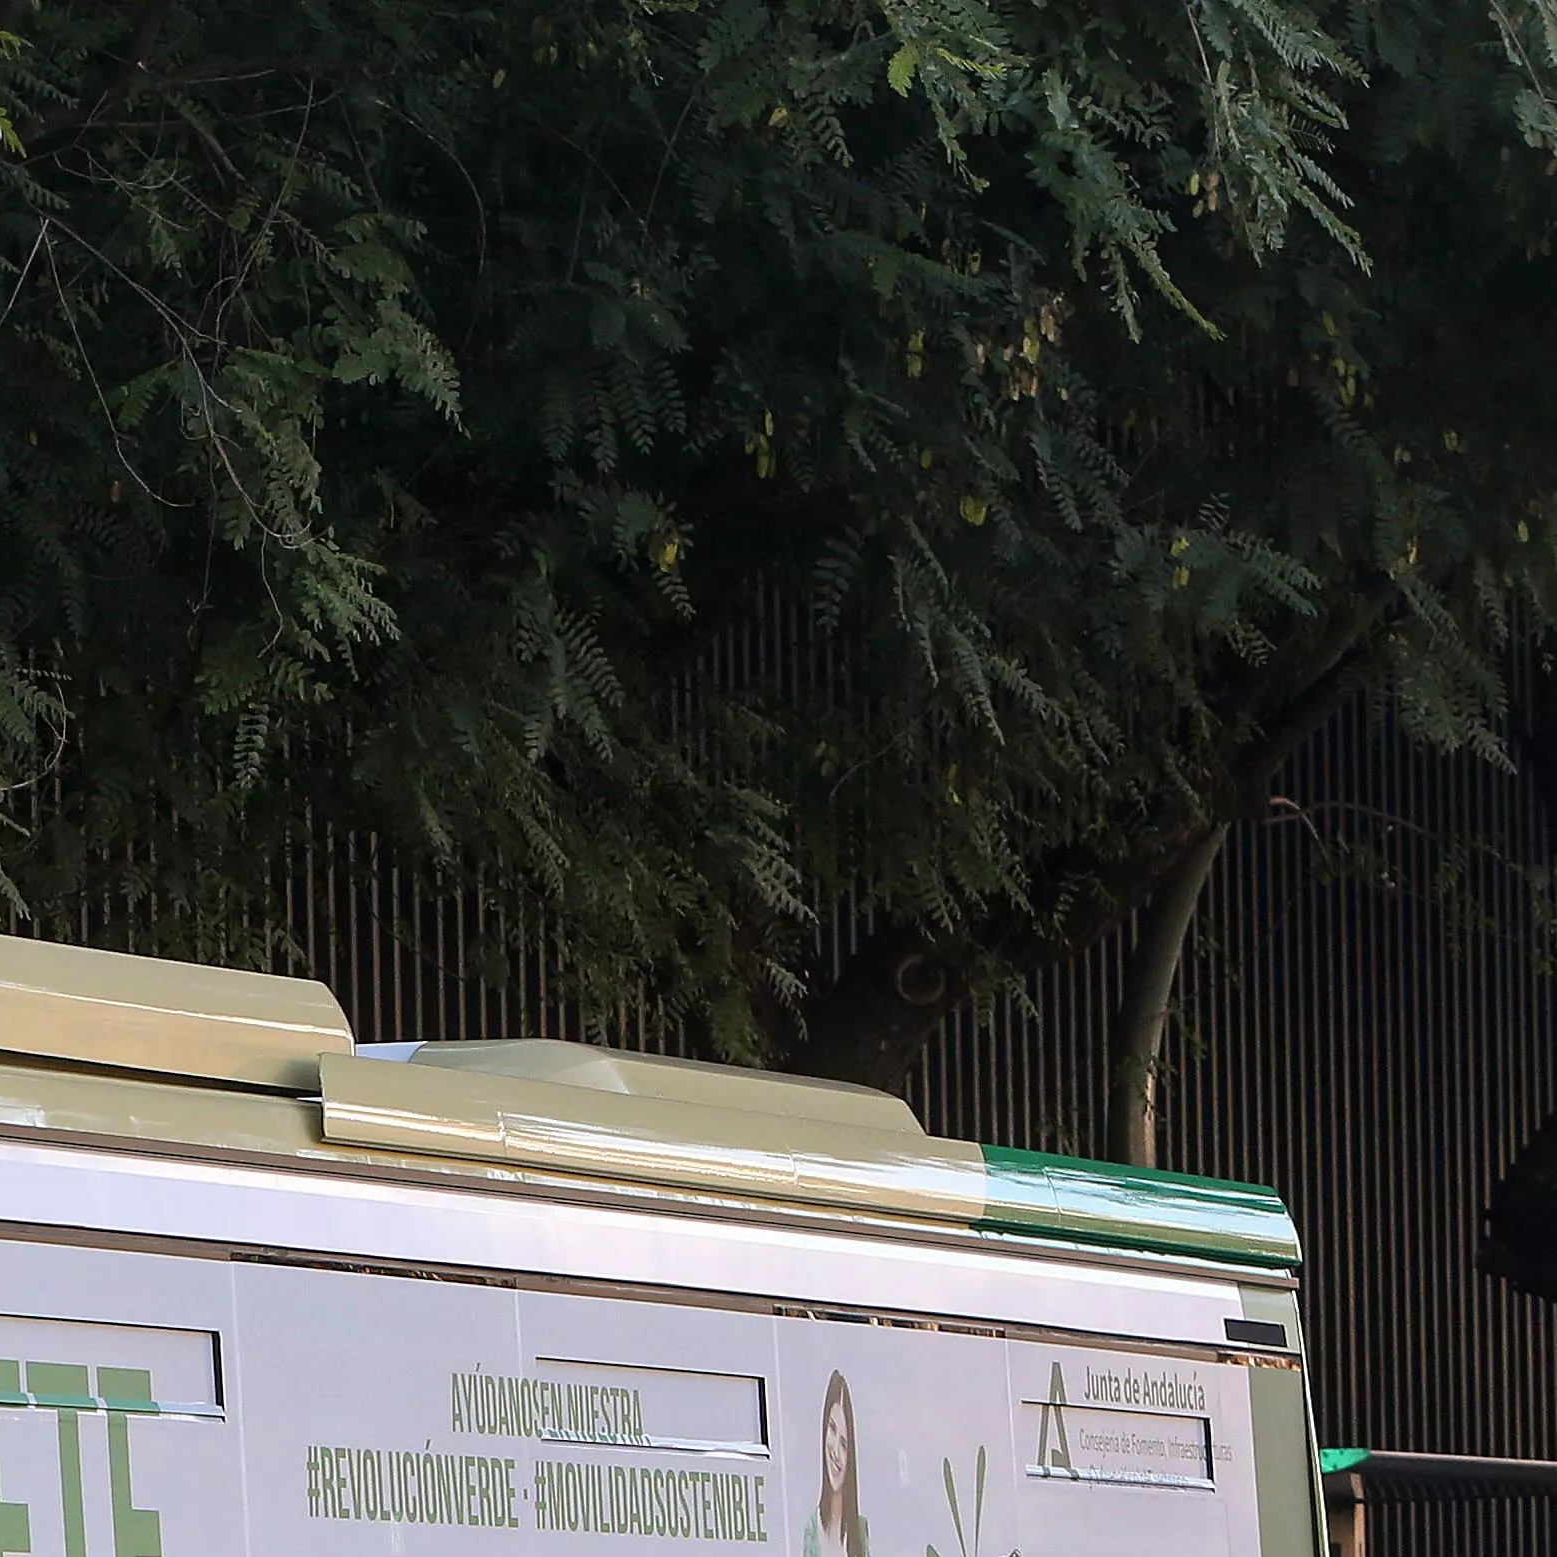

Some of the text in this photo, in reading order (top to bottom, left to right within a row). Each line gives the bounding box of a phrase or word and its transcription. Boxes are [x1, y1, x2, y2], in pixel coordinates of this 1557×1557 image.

[451, 1362, 541, 1438] AYÚDANOS
[1085, 1366, 1206, 1410] Junta de Andalucía
[307, 1439, 768, 1543] #REVOLUCIÓNVERDE #MOVILIDADSOSTENIBLE
